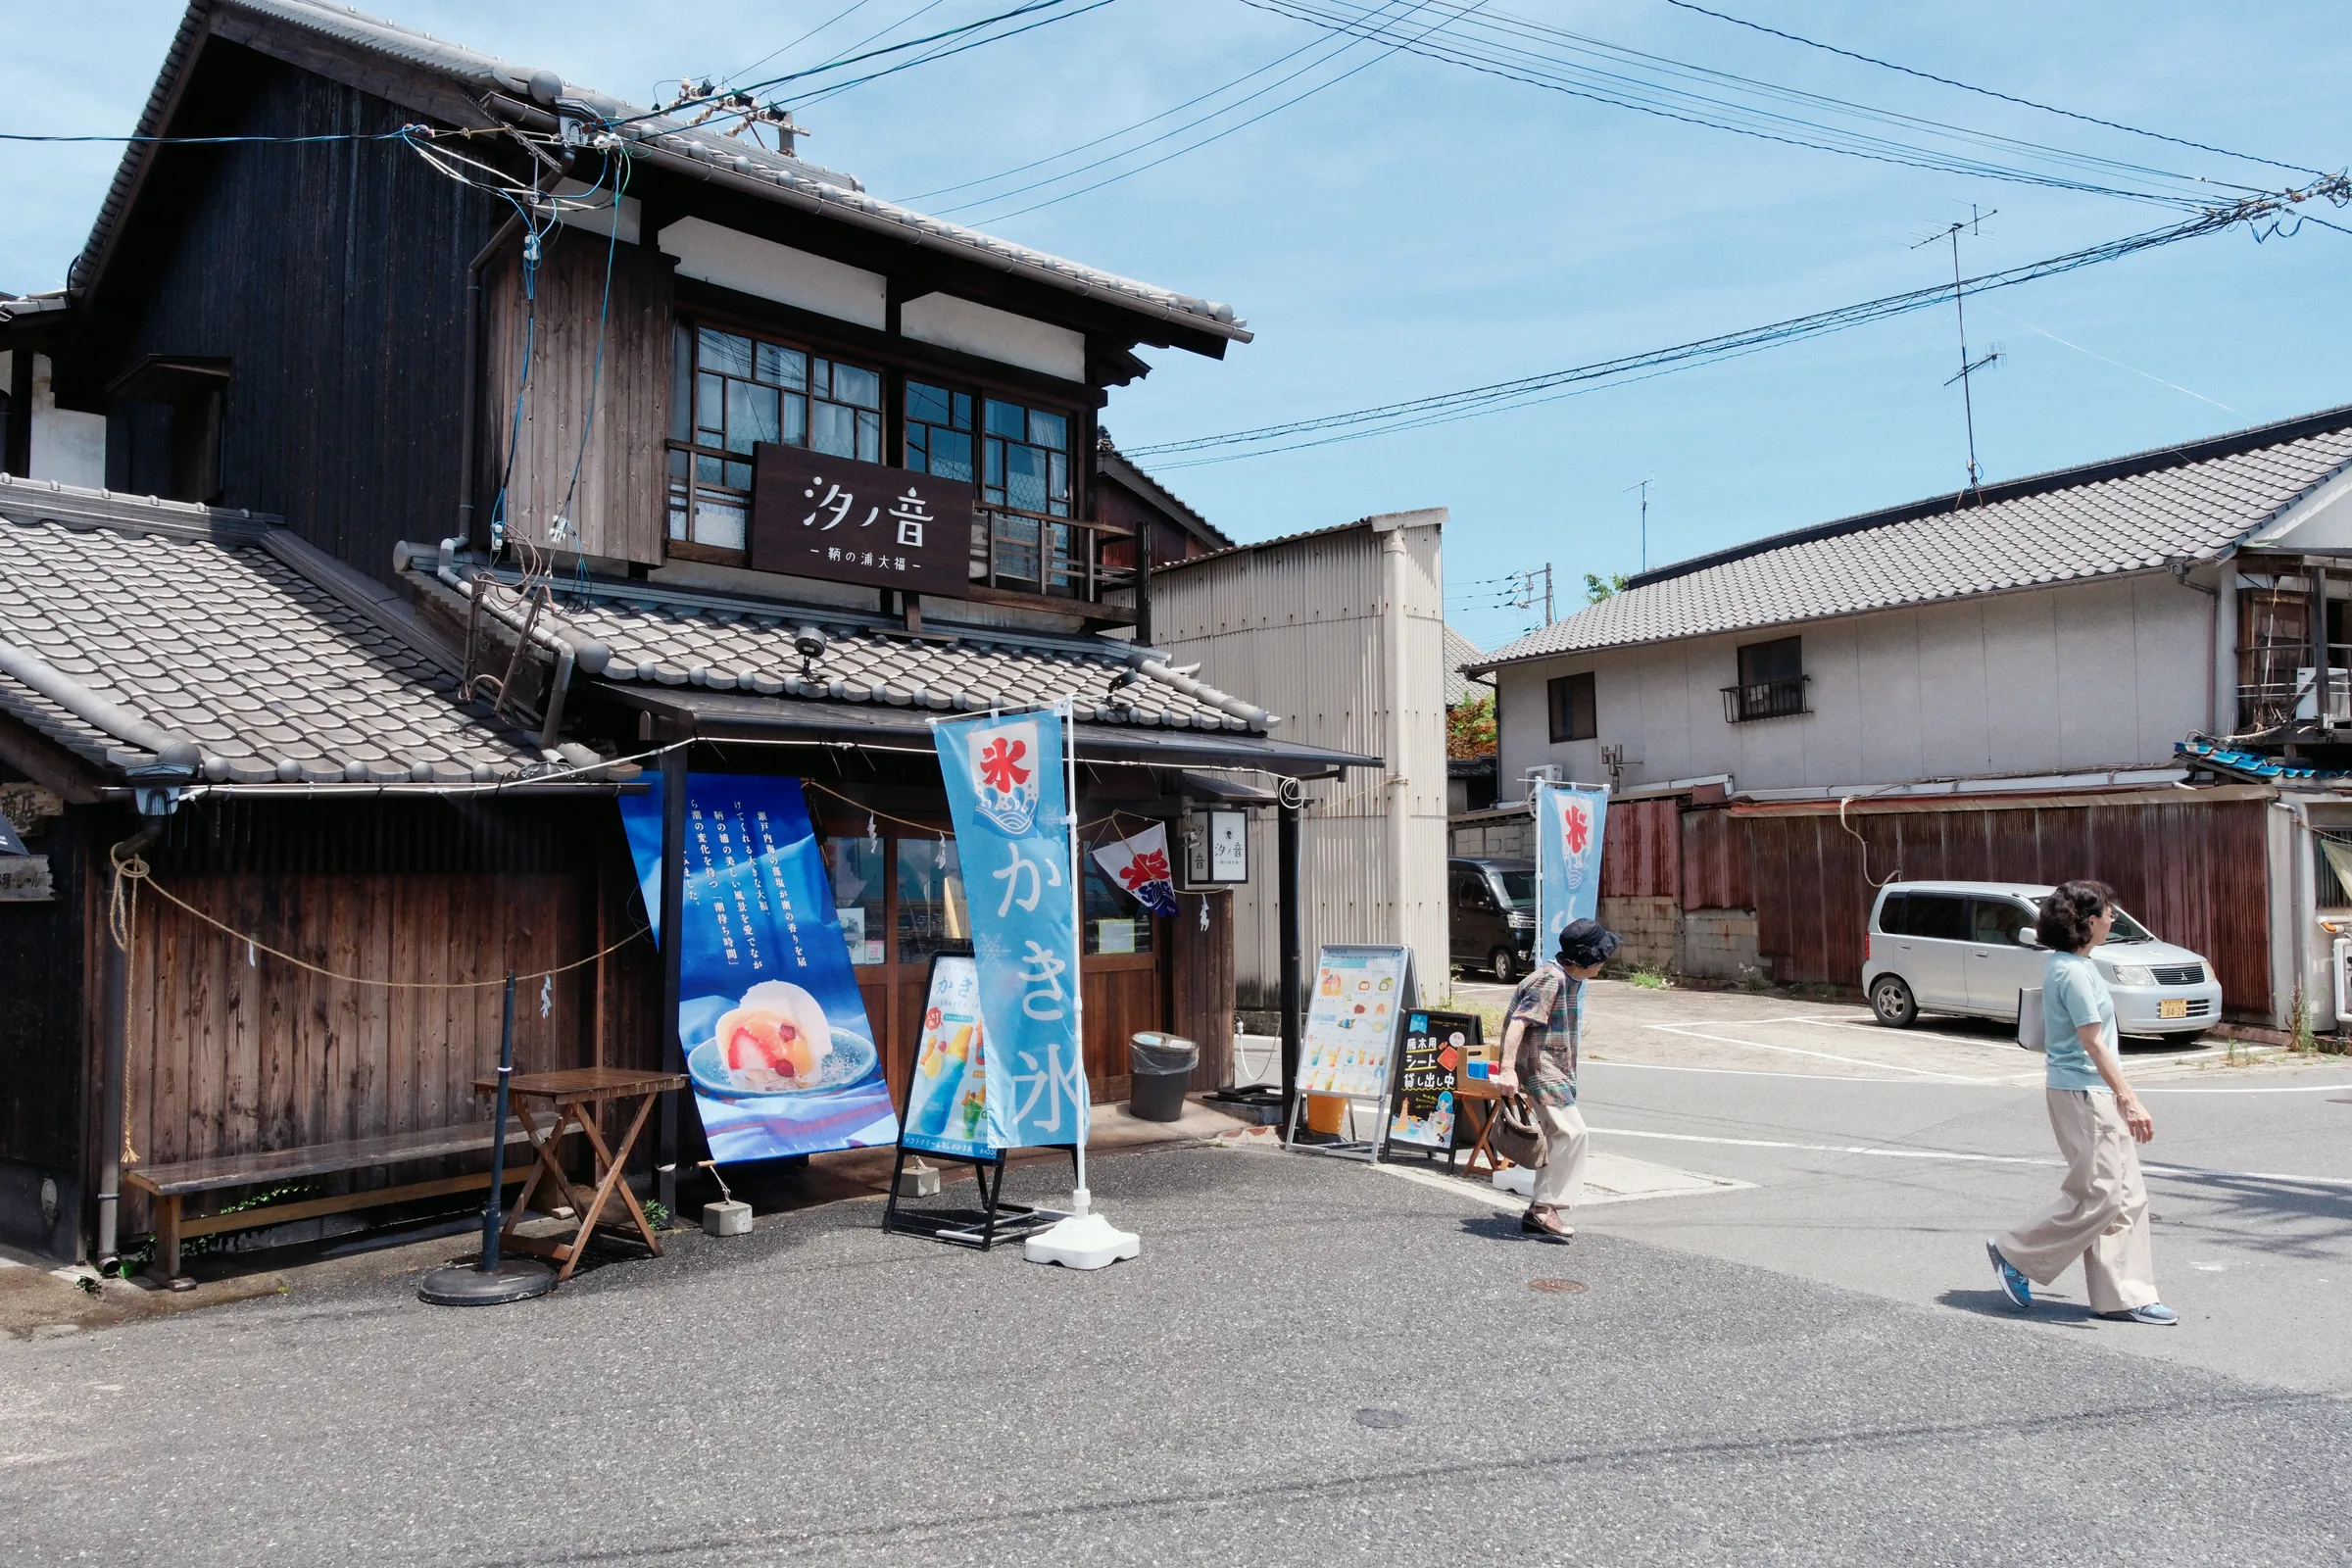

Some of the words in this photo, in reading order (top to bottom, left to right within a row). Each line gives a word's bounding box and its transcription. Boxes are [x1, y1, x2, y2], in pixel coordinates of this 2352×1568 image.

[803, 476, 934, 547] 汐ノ音
[980, 737, 1031, 793] 氷
[1215, 842, 1243, 858] 汐ノ音
[936, 975, 980, 998] かき
[993, 842, 1078, 1132] かき氷
[2167, 1007, 2184, 1016] 84-26
[1407, 1037, 1437, 1051] 雁木用
[1406, 1054, 1436, 1068] シート
[1404, 1072, 1455, 1090] 貸し出し中
